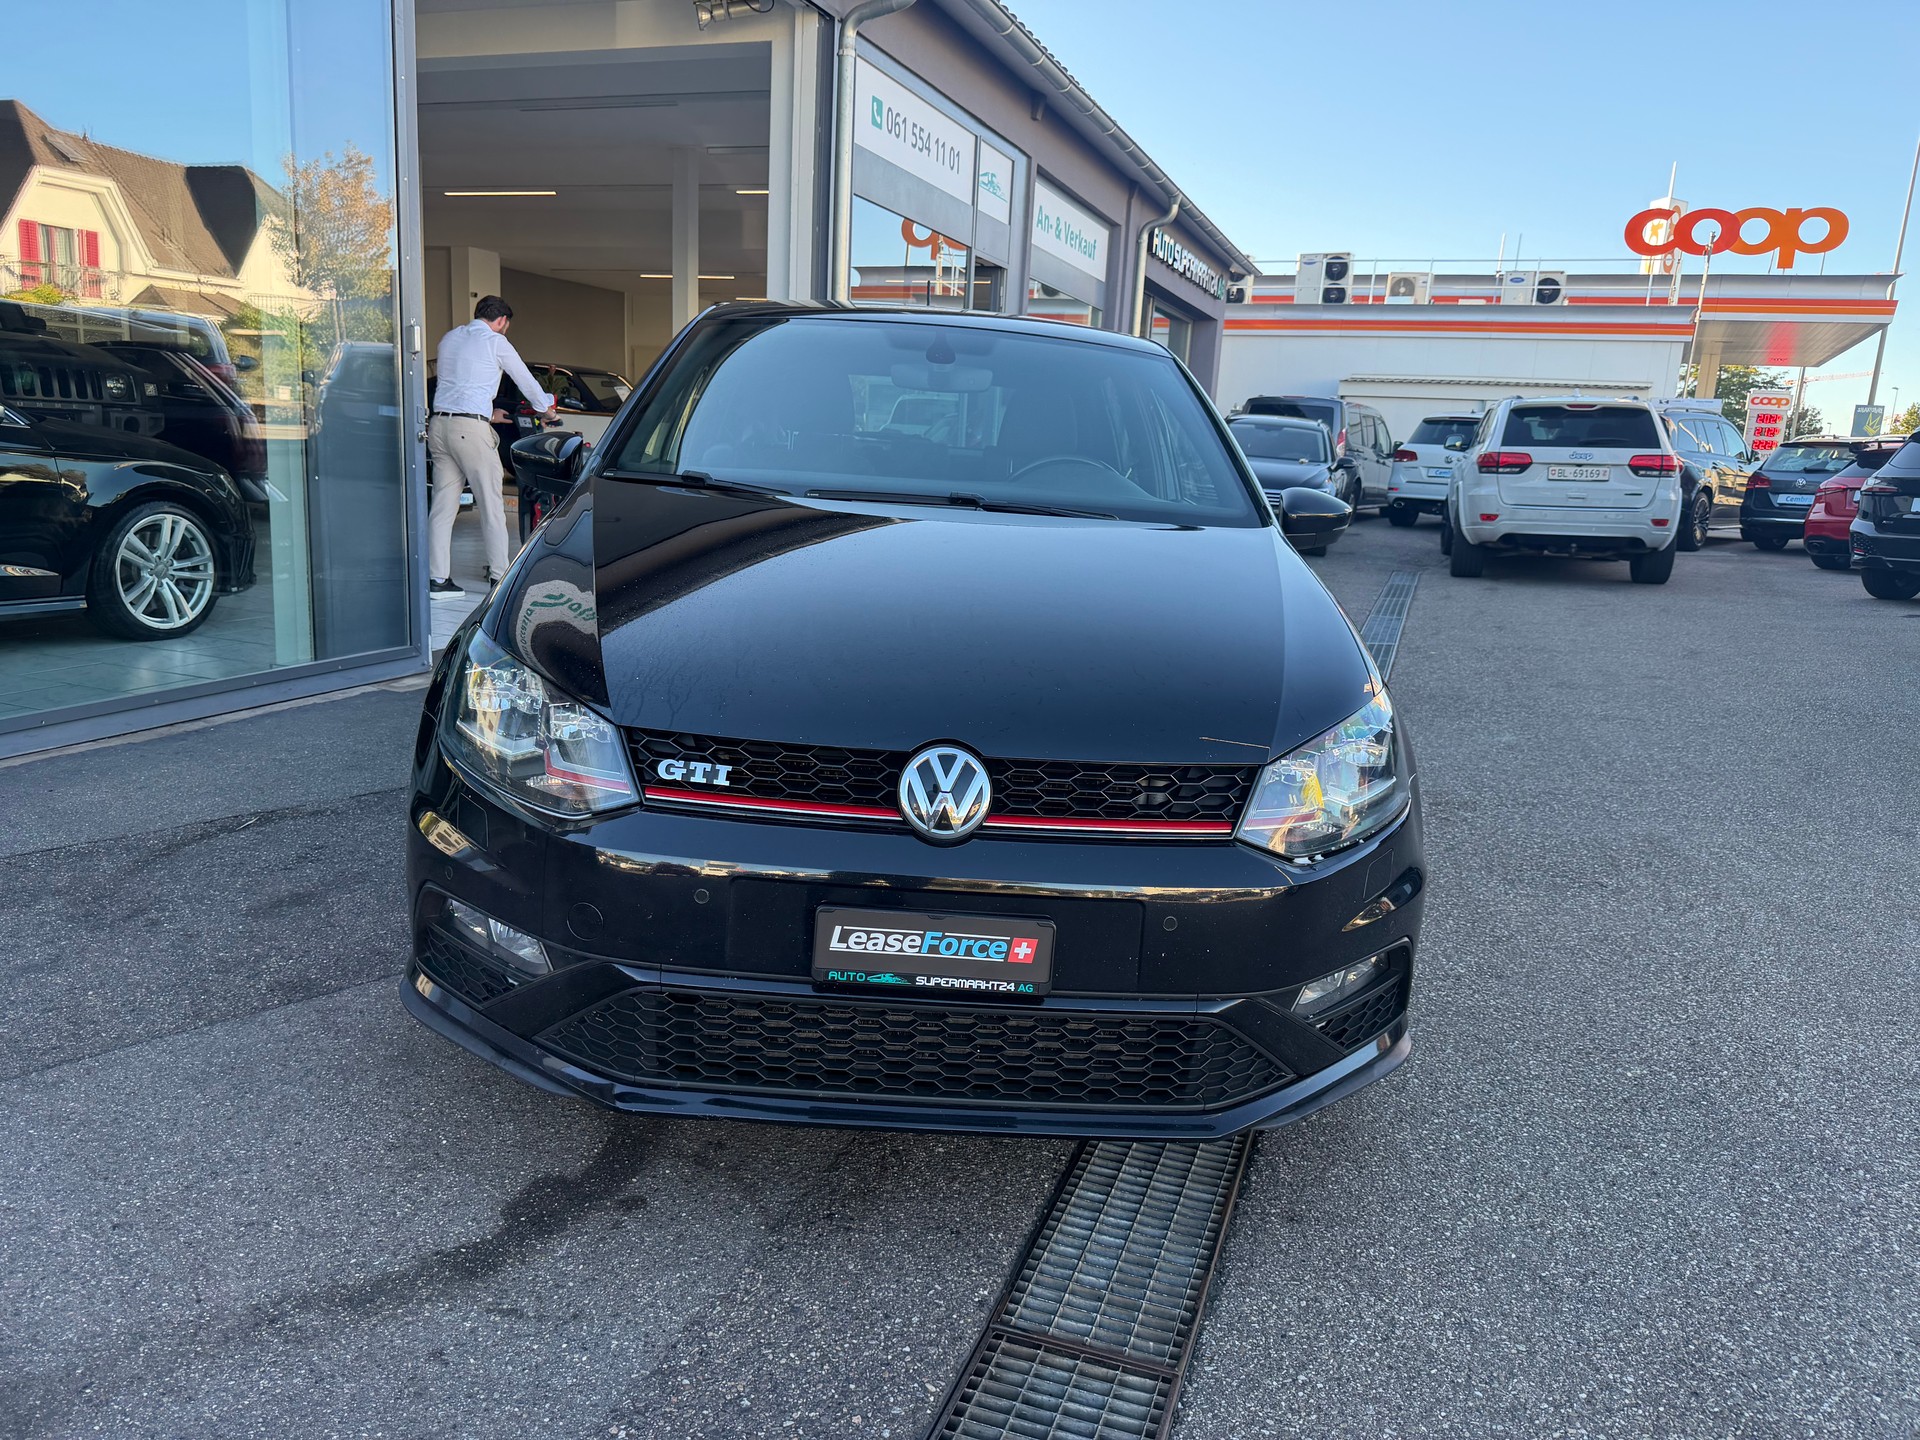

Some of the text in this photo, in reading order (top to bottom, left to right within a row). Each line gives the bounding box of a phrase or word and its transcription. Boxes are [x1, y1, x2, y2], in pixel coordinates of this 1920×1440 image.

[886, 106, 960, 175] 061 554 11 01
[1036, 205, 1097, 261] An- & Verkauf
[1152, 227, 1175, 266] AUTO
[1624, 207, 1849, 269] coop
[1750, 396, 1790, 408] coop
[1569, 451, 1593, 461] Jeep
[657, 758, 732, 787] GTI
[828, 971, 866, 983] AUTO
[1017, 983, 1034, 994] AG
